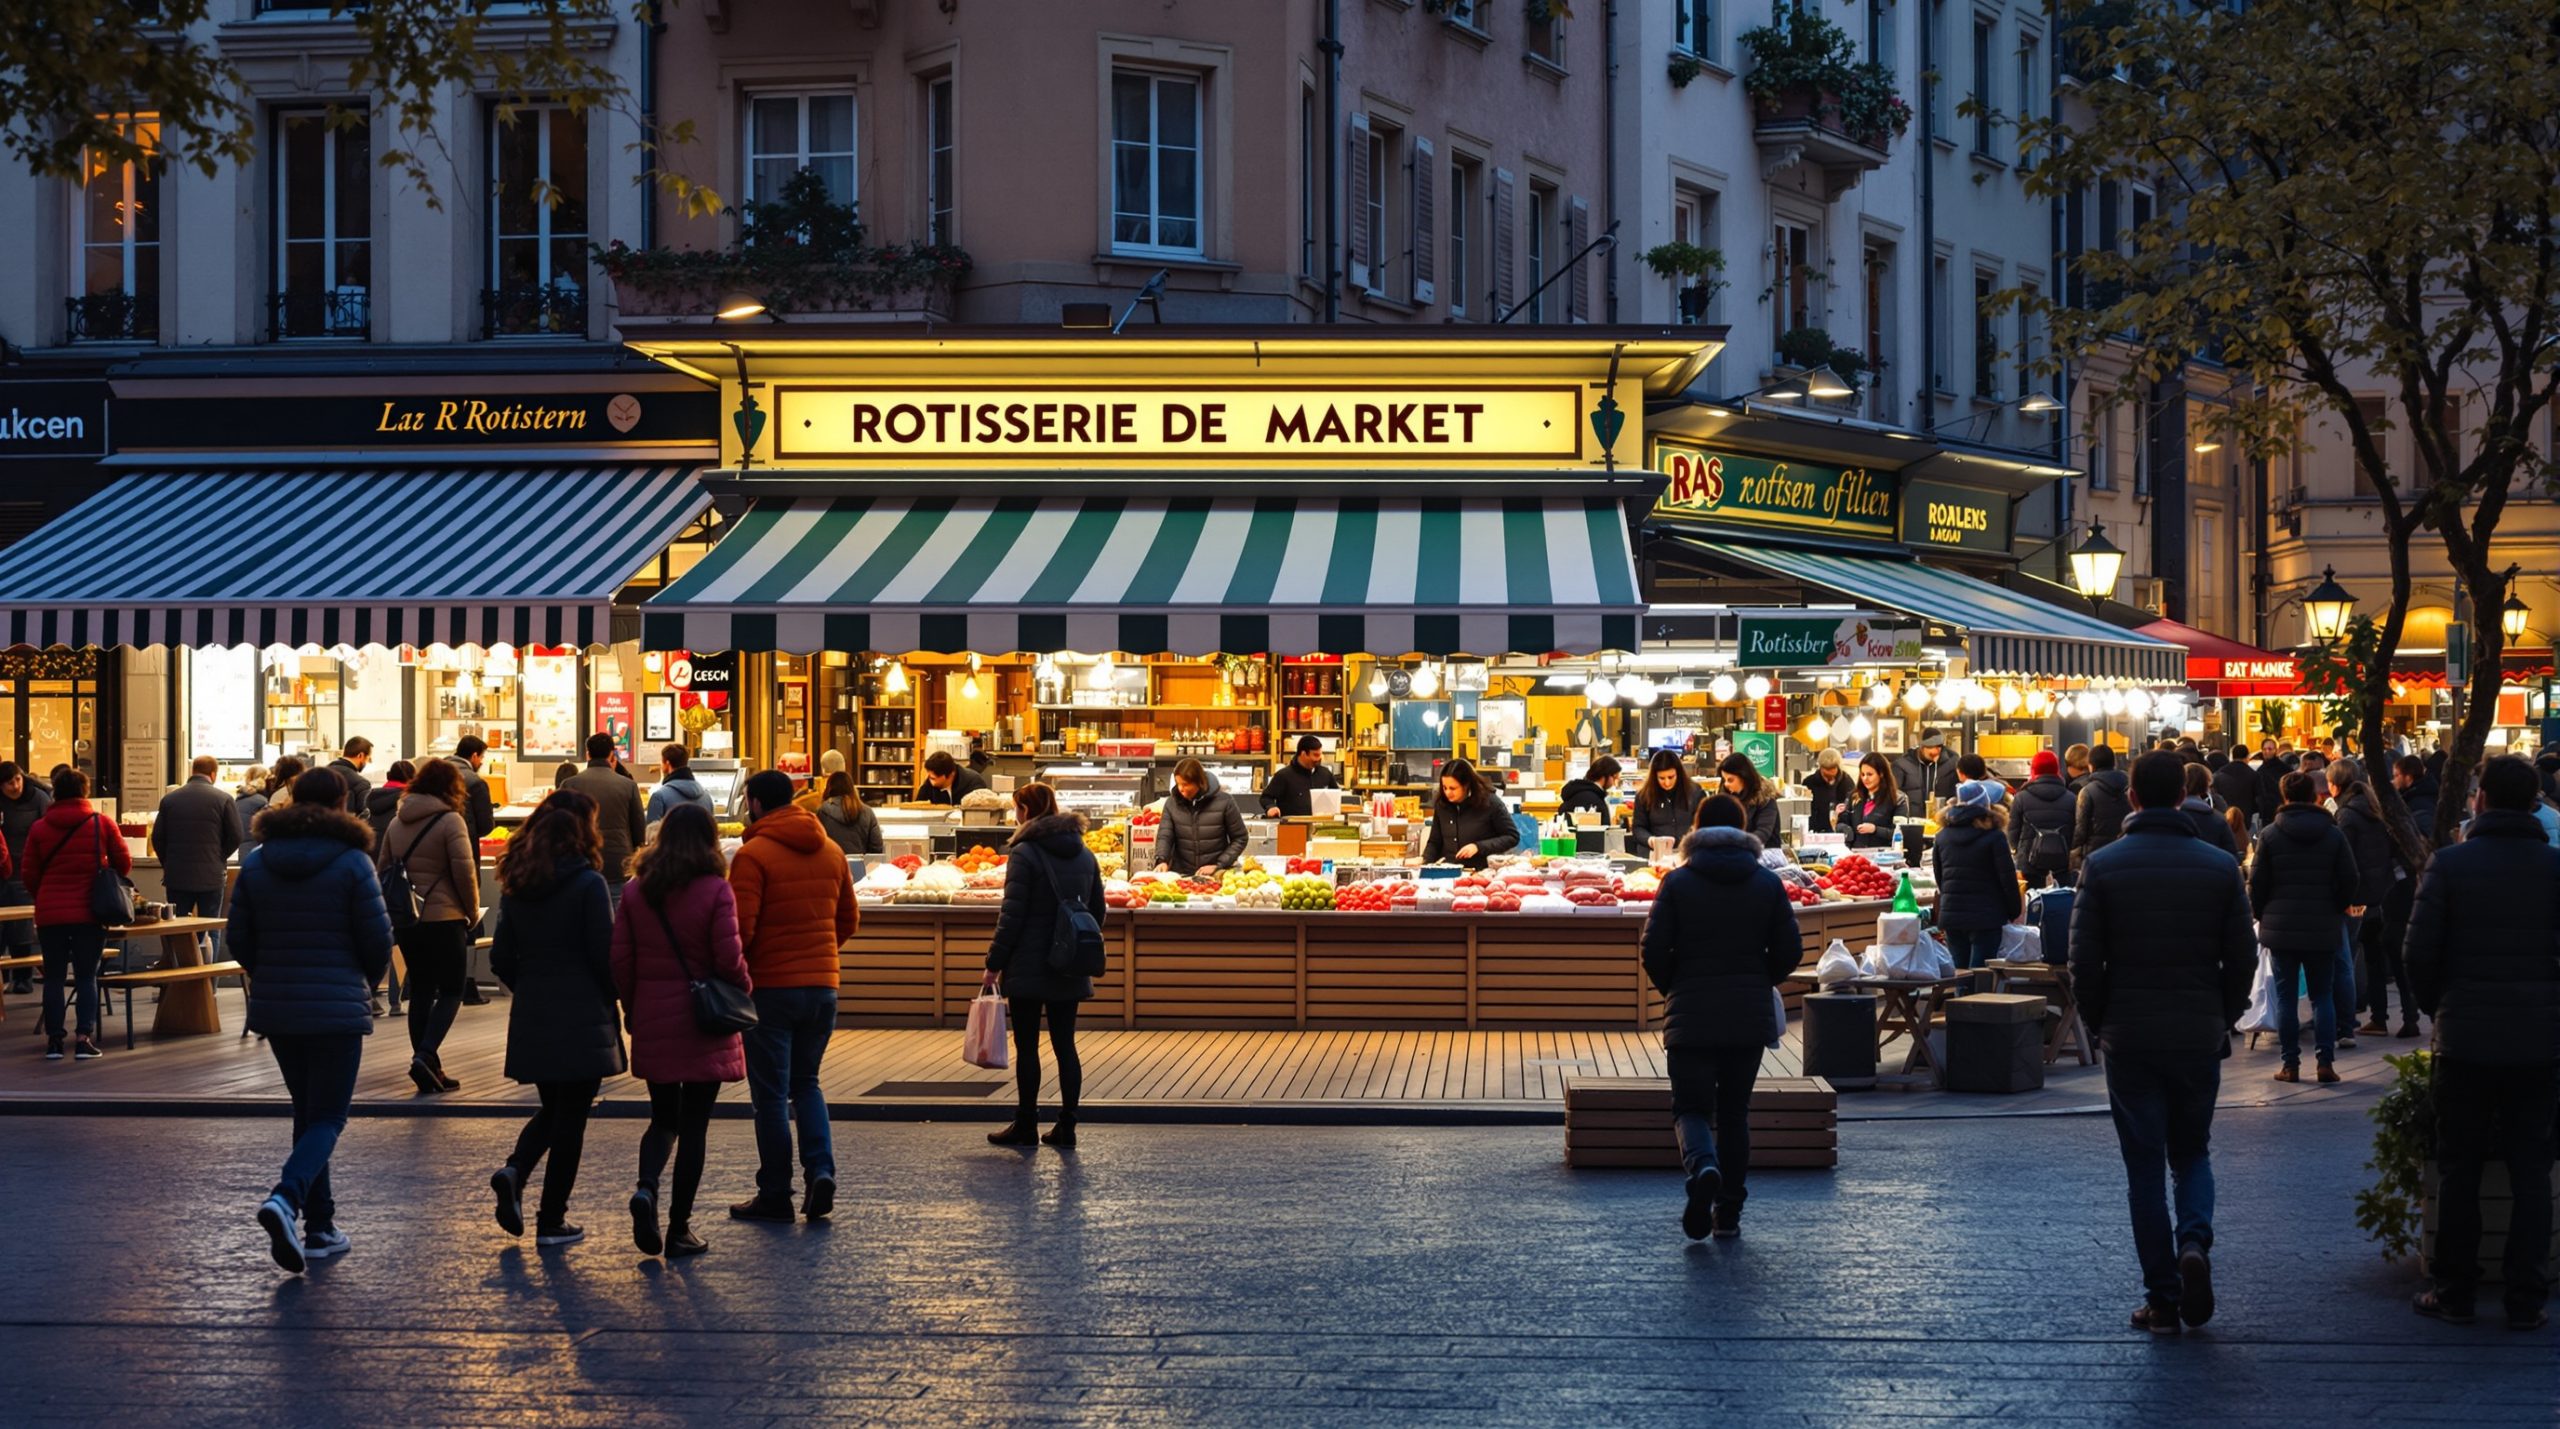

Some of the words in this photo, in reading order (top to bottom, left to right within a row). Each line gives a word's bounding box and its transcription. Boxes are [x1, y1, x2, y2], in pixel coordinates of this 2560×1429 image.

[853, 403, 1138, 443] ROTISSERIE
[1162, 403, 1227, 443] DE
[1265, 403, 1484, 443] MARKET
[1671, 453, 1724, 506] RAS
[2225, 661, 2249, 678] EAT
